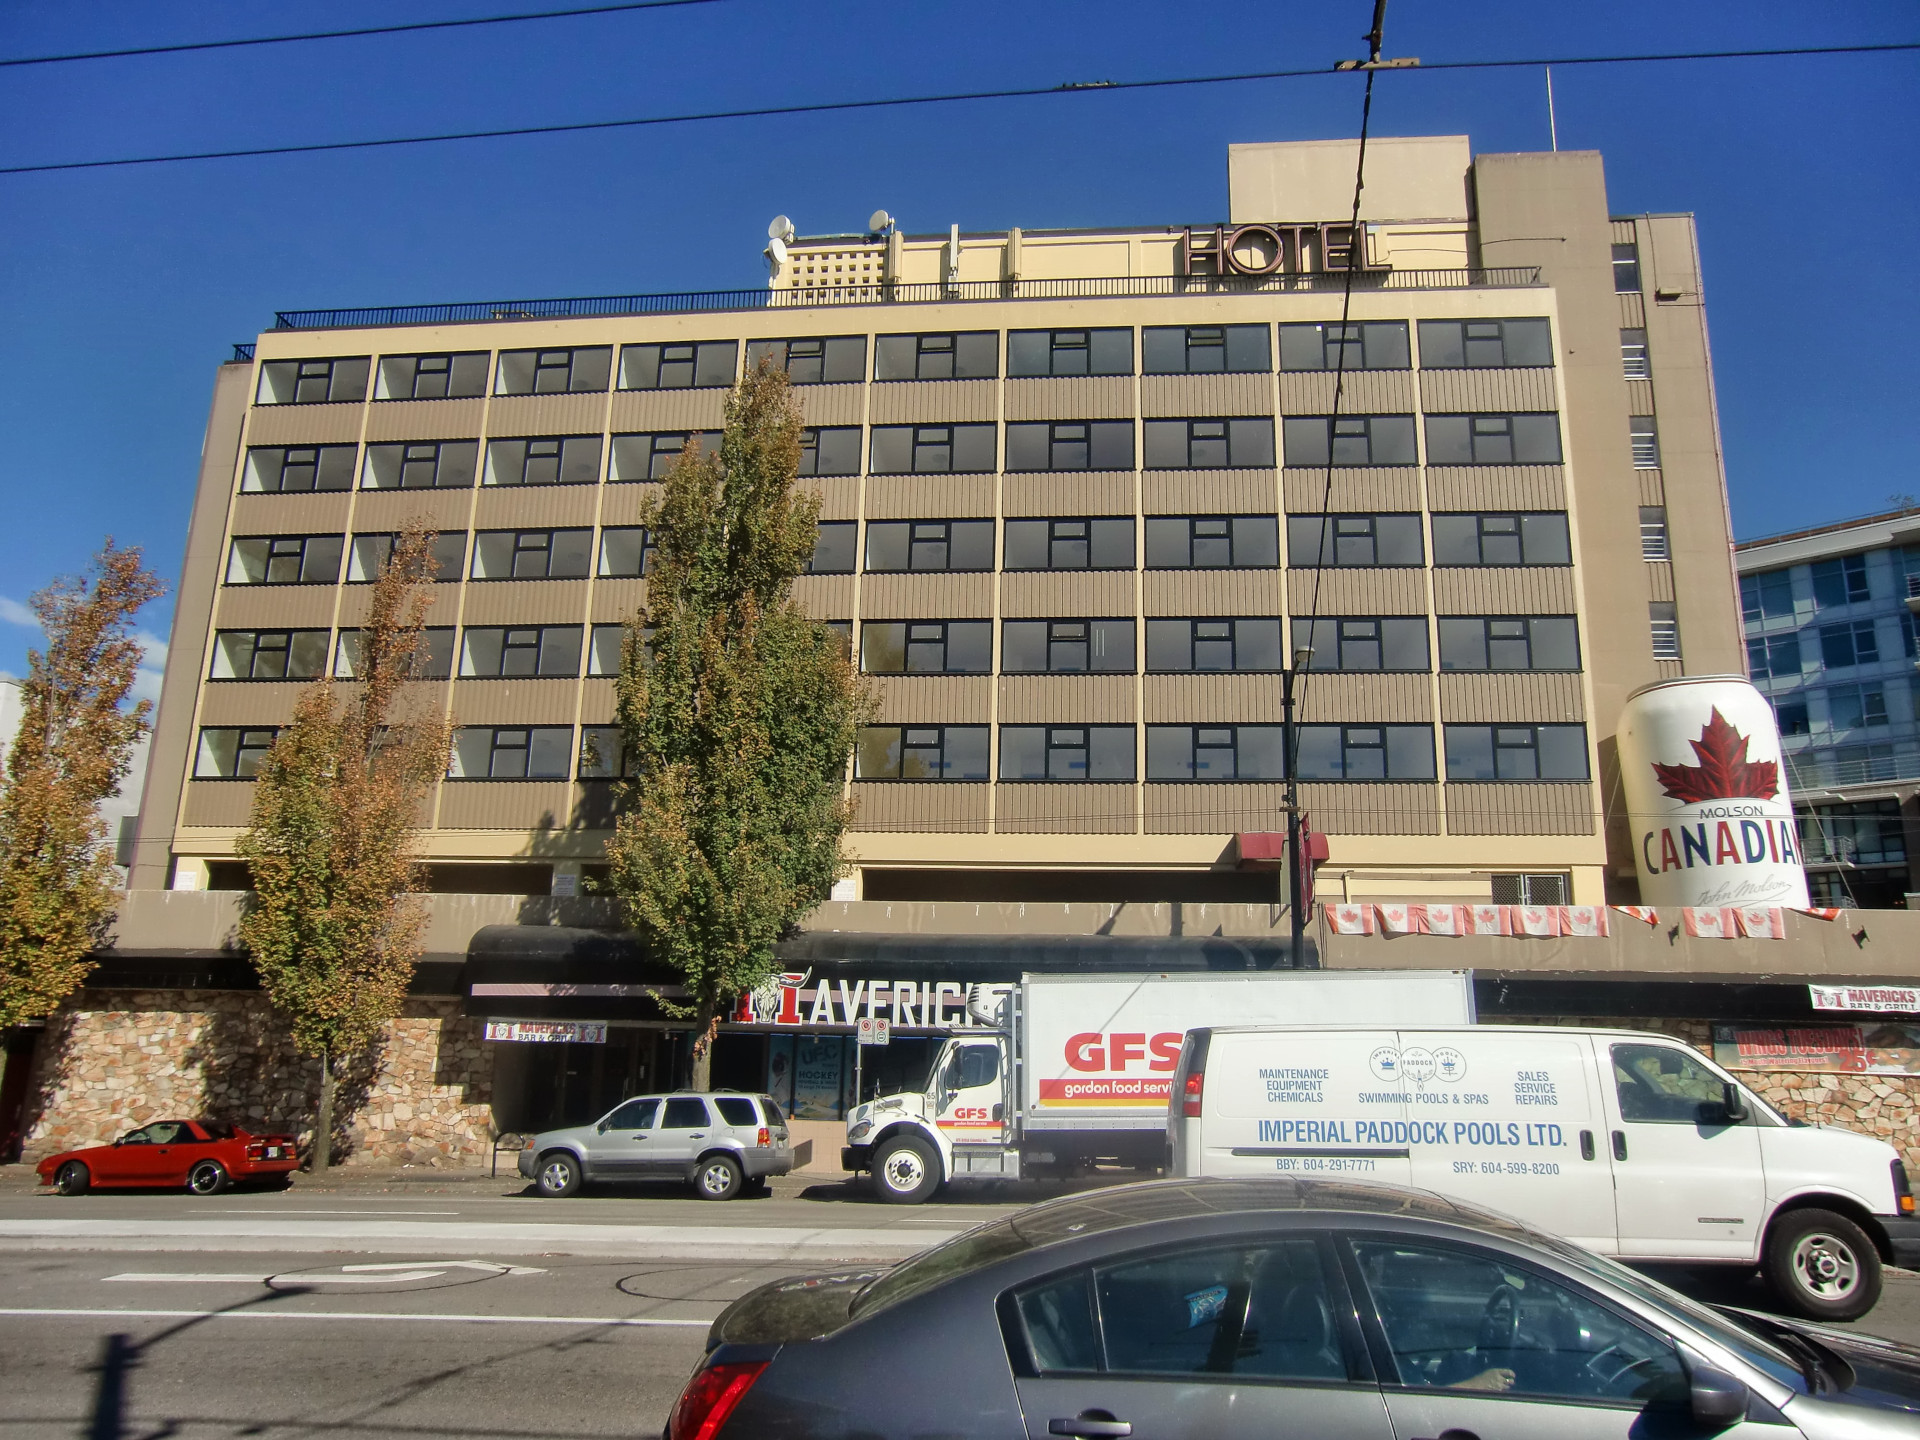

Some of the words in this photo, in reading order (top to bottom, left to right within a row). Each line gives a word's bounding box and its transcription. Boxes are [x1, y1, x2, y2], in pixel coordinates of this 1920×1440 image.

[1184, 222, 1394, 276] HOTEL
[1700, 806, 1764, 820] MOLSON
[1847, 989, 1916, 1004] MAVERICKS
[1850, 1002, 1871, 1010] BAR
[1874, 1003, 1882, 1011] &
[1884, 1002, 1918, 1012] GRILL
[519, 1021, 577, 1035] MAVERICKS
[518, 1033, 537, 1042] BAR
[539, 1034, 546, 1042] &
[547, 1034, 576, 1043] GRILL
[1734, 1029, 1787, 1057] WINGS
[1786, 1027, 1866, 1055] TUESDAYS!
[801, 1044, 838, 1065] UFC
[1064, 1031, 1184, 1073] GFS
[1372, 1050, 1400, 1060] IMPERIAL
[1435, 1051, 1459, 1059] POOLS
[1402, 1059, 1434, 1067] PADDOCK
[798, 1071, 838, 1080] HOCKEY
[1259, 1068, 1329, 1079] MAINTENANCE
[1517, 1071, 1549, 1082] SALES
[1064, 1080, 1110, 1098] gordon
[1111, 1080, 1142, 1094] food
[1266, 1080, 1323, 1092] EQUIPMENT
[1514, 1082, 1557, 1094] SERVICE
[1267, 1091, 1324, 1103] CHEMICALS
[1358, 1092, 1412, 1103] SWIMMING
[1415, 1093, 1449, 1104] POOLS
[1452, 1094, 1460, 1104] &
[1463, 1094, 1489, 1104] SPAS
[1515, 1094, 1558, 1106] REPAIRS
[954, 1107, 987, 1119] GFS
[1258, 1120, 1352, 1143] IMPERIAL
[1355, 1120, 1449, 1145] PADDOCK
[1453, 1121, 1521, 1146] POOLS
[1526, 1123, 1568, 1147] LTD.
[1276, 1158, 1300, 1170] BBY:
[1303, 1159, 1376, 1171] 604-291-7771
[1453, 1161, 1478, 1173] SRY:
[1481, 1161, 1560, 1175] 604-599-8200
